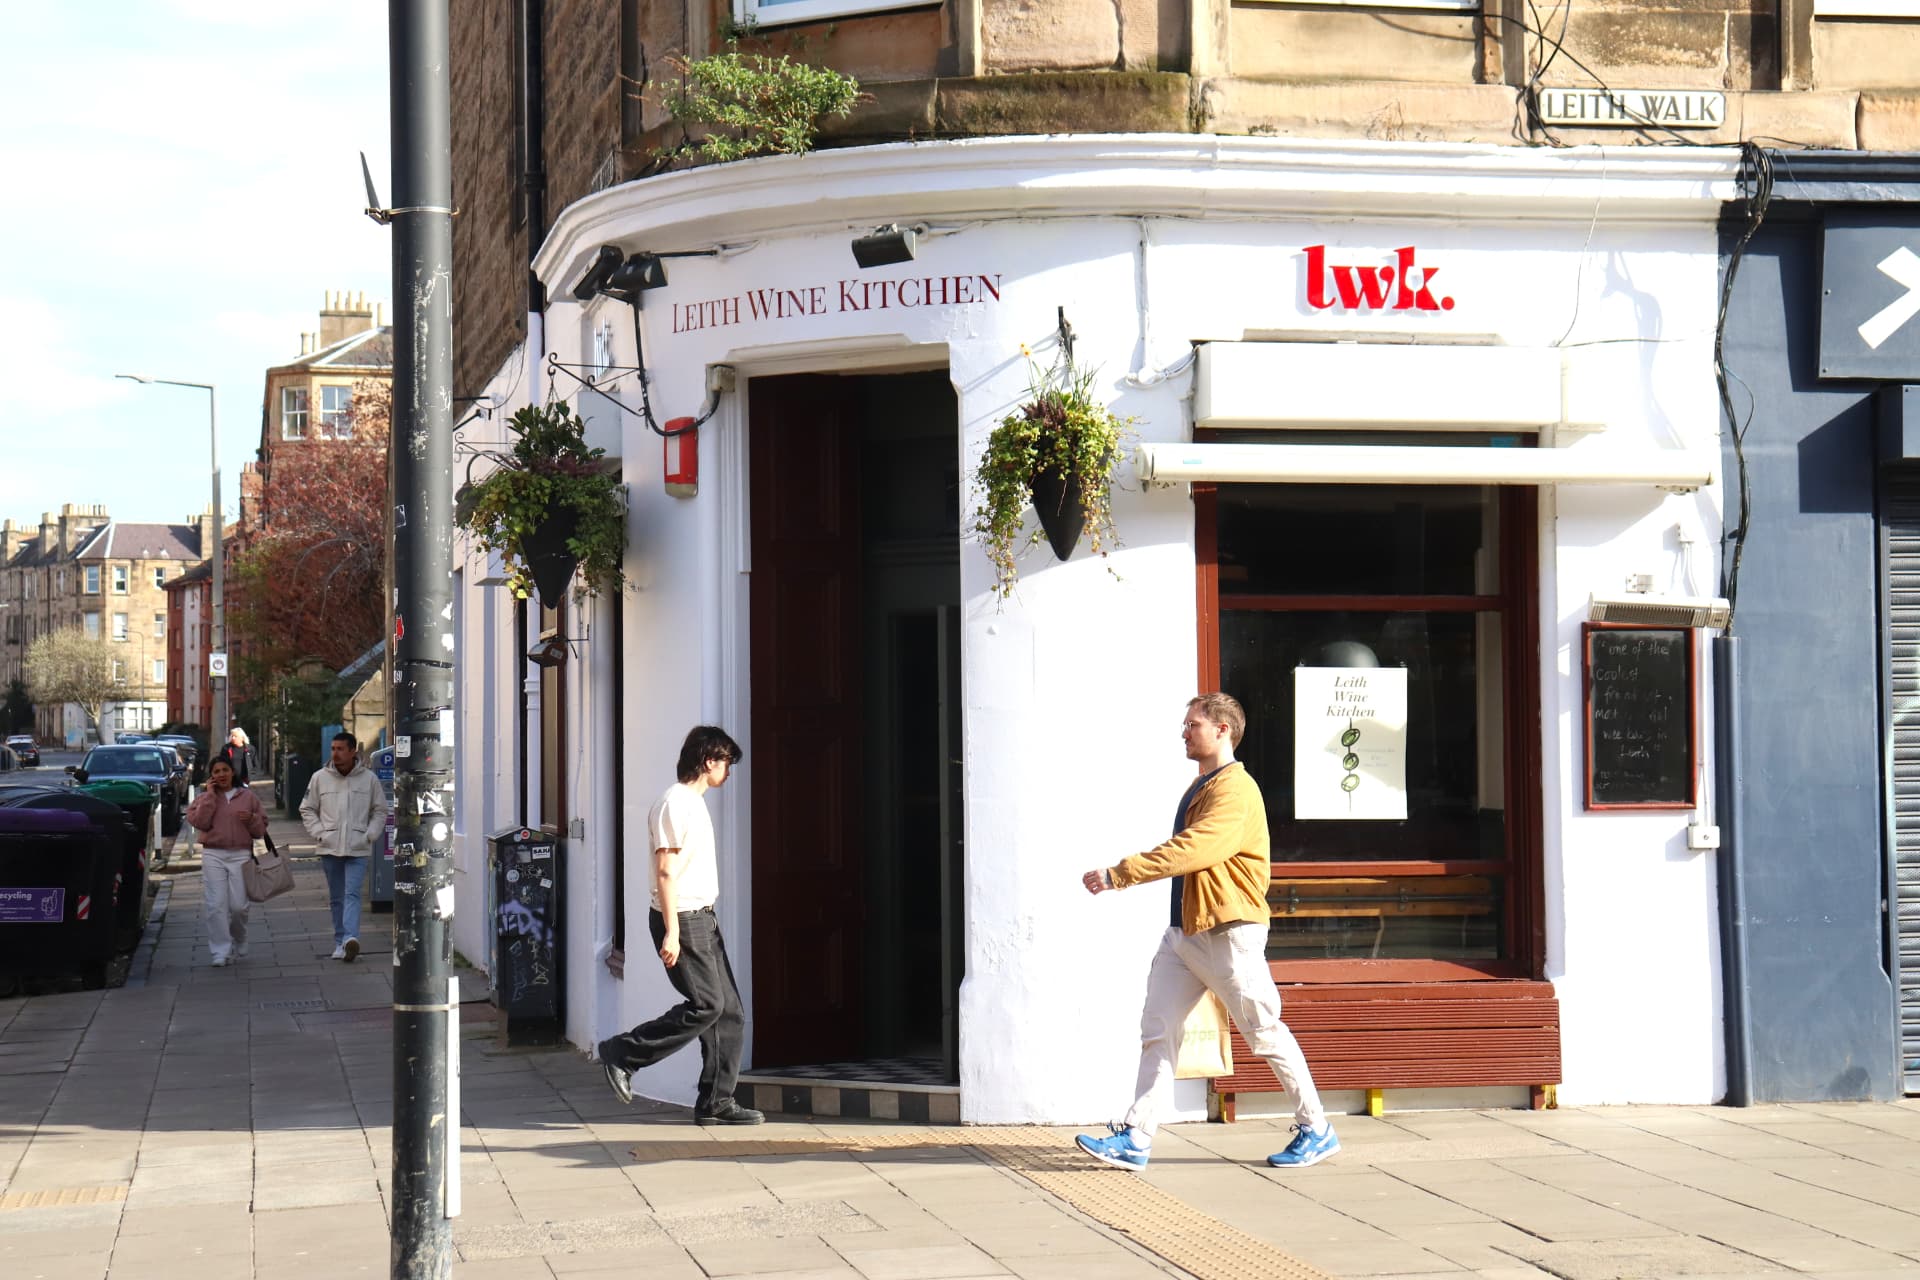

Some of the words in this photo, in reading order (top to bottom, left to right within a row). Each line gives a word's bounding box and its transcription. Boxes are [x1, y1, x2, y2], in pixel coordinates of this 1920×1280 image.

[1546, 91, 1626, 121] LEITH
[1640, 92, 1720, 122] WALK
[672, 295, 741, 334] LEITH
[746, 286, 828, 321] WINE
[837, 273, 1003, 312] KITCHEN
[1334, 676, 1367, 688] Leith
[1335, 691, 1368, 702] Wine
[1326, 705, 1375, 717] Kitchen
[0, 890, 32, 900] ecycling
